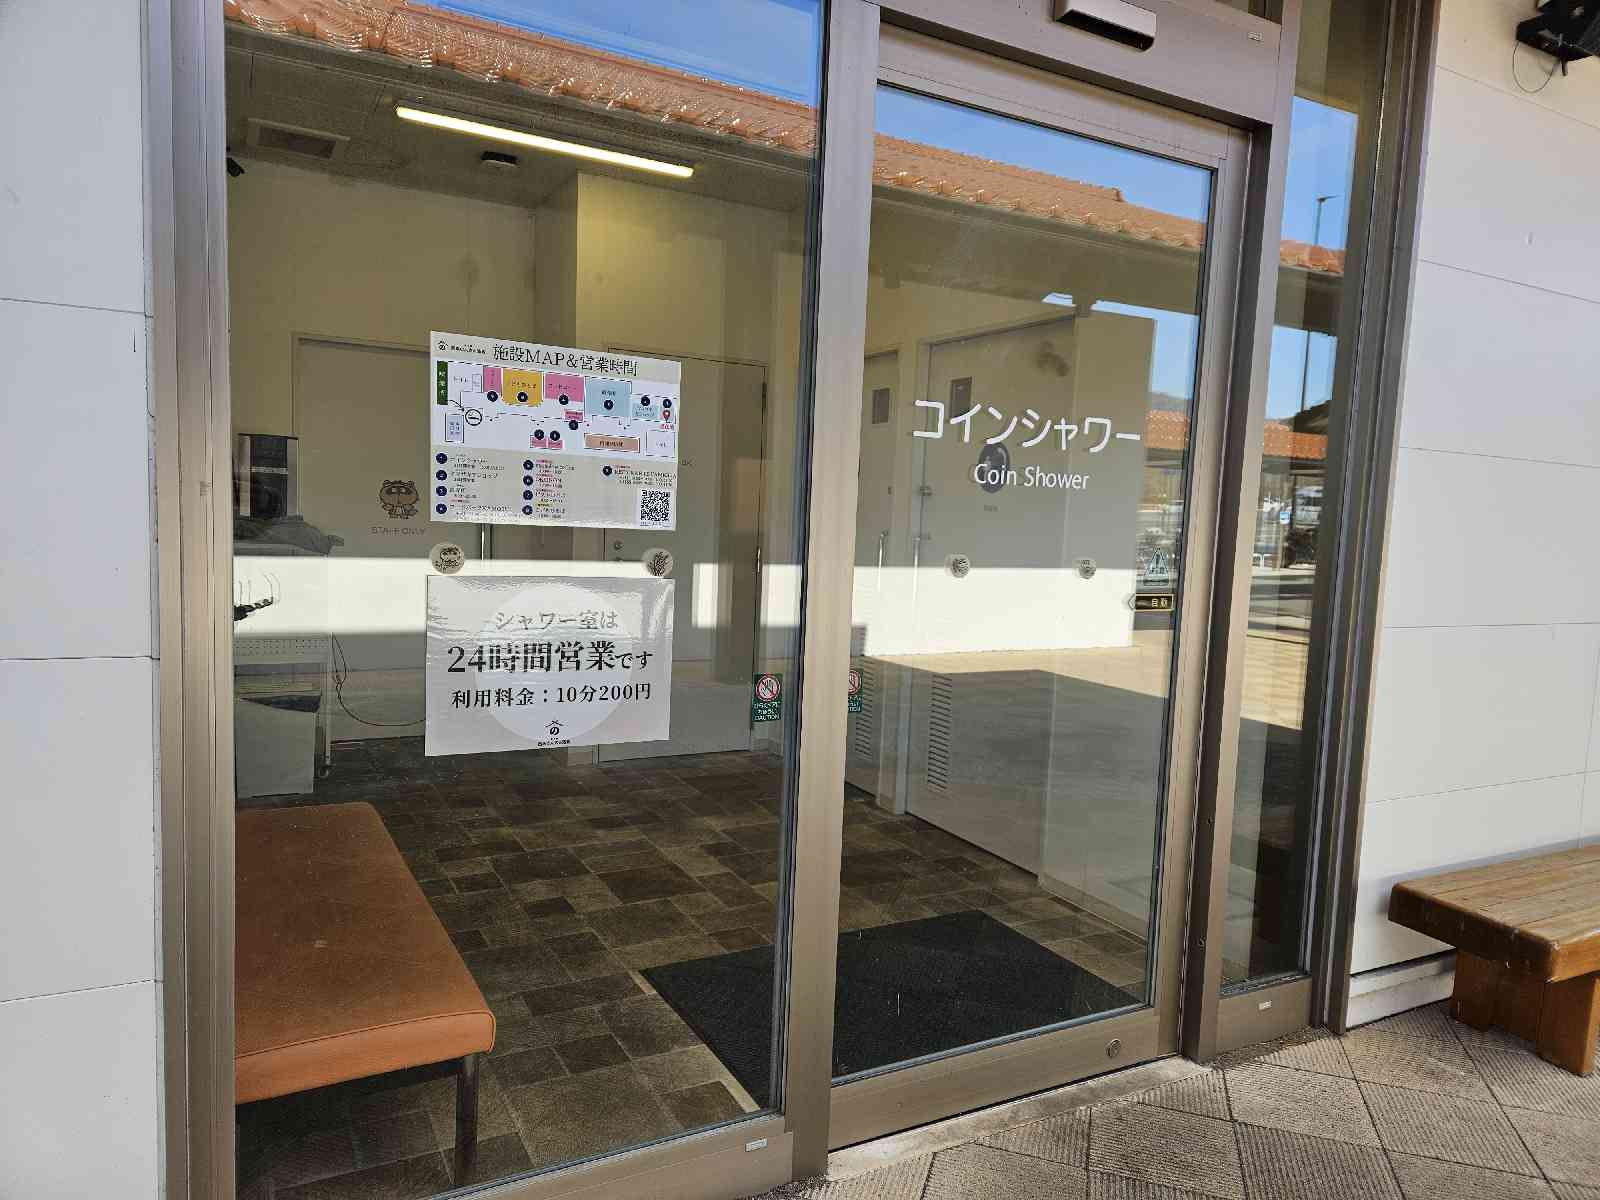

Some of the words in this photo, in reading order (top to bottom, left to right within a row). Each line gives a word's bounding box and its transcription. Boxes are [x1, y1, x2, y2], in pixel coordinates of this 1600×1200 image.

[493, 343, 638, 378] 施設MAP&営業時間
[912, 399, 1141, 453] コインシャワー
[974, 463, 1018, 486] Coin
[1024, 466, 1089, 490] Shower
[495, 609, 619, 631] シャワー室は
[447, 640, 654, 674] 24時間営業です
